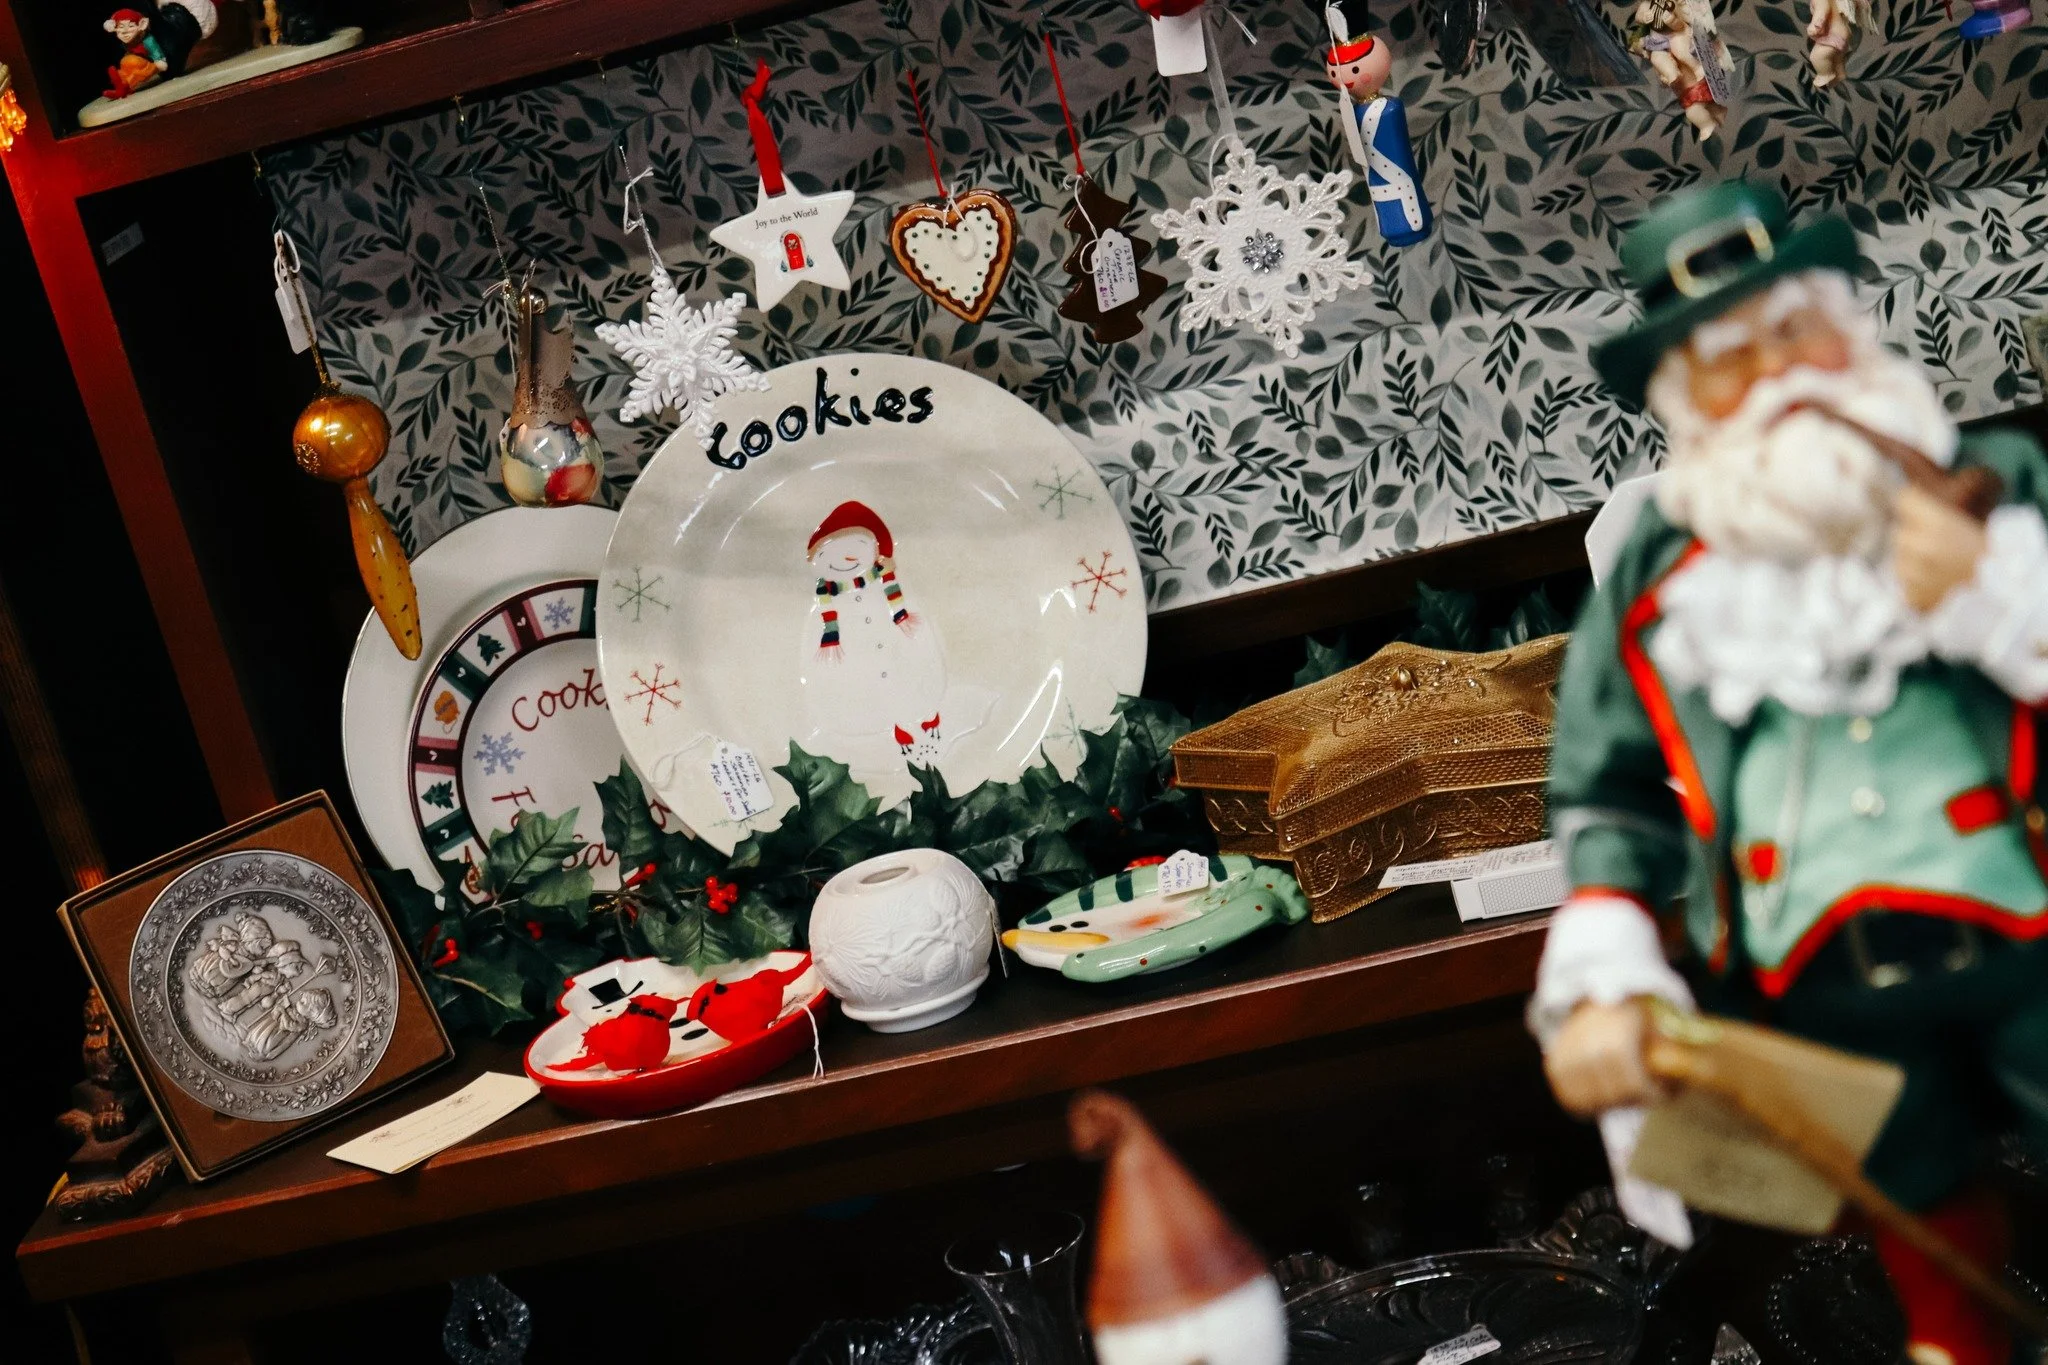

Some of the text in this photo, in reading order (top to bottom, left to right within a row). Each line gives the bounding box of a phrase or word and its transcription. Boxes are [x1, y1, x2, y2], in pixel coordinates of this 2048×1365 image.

[755, 208, 818, 229] Joy to the World
[1114, 248, 1125, 282] Ceramic
[706, 366, 934, 470] Cookies
[511, 668, 610, 732] Cook
